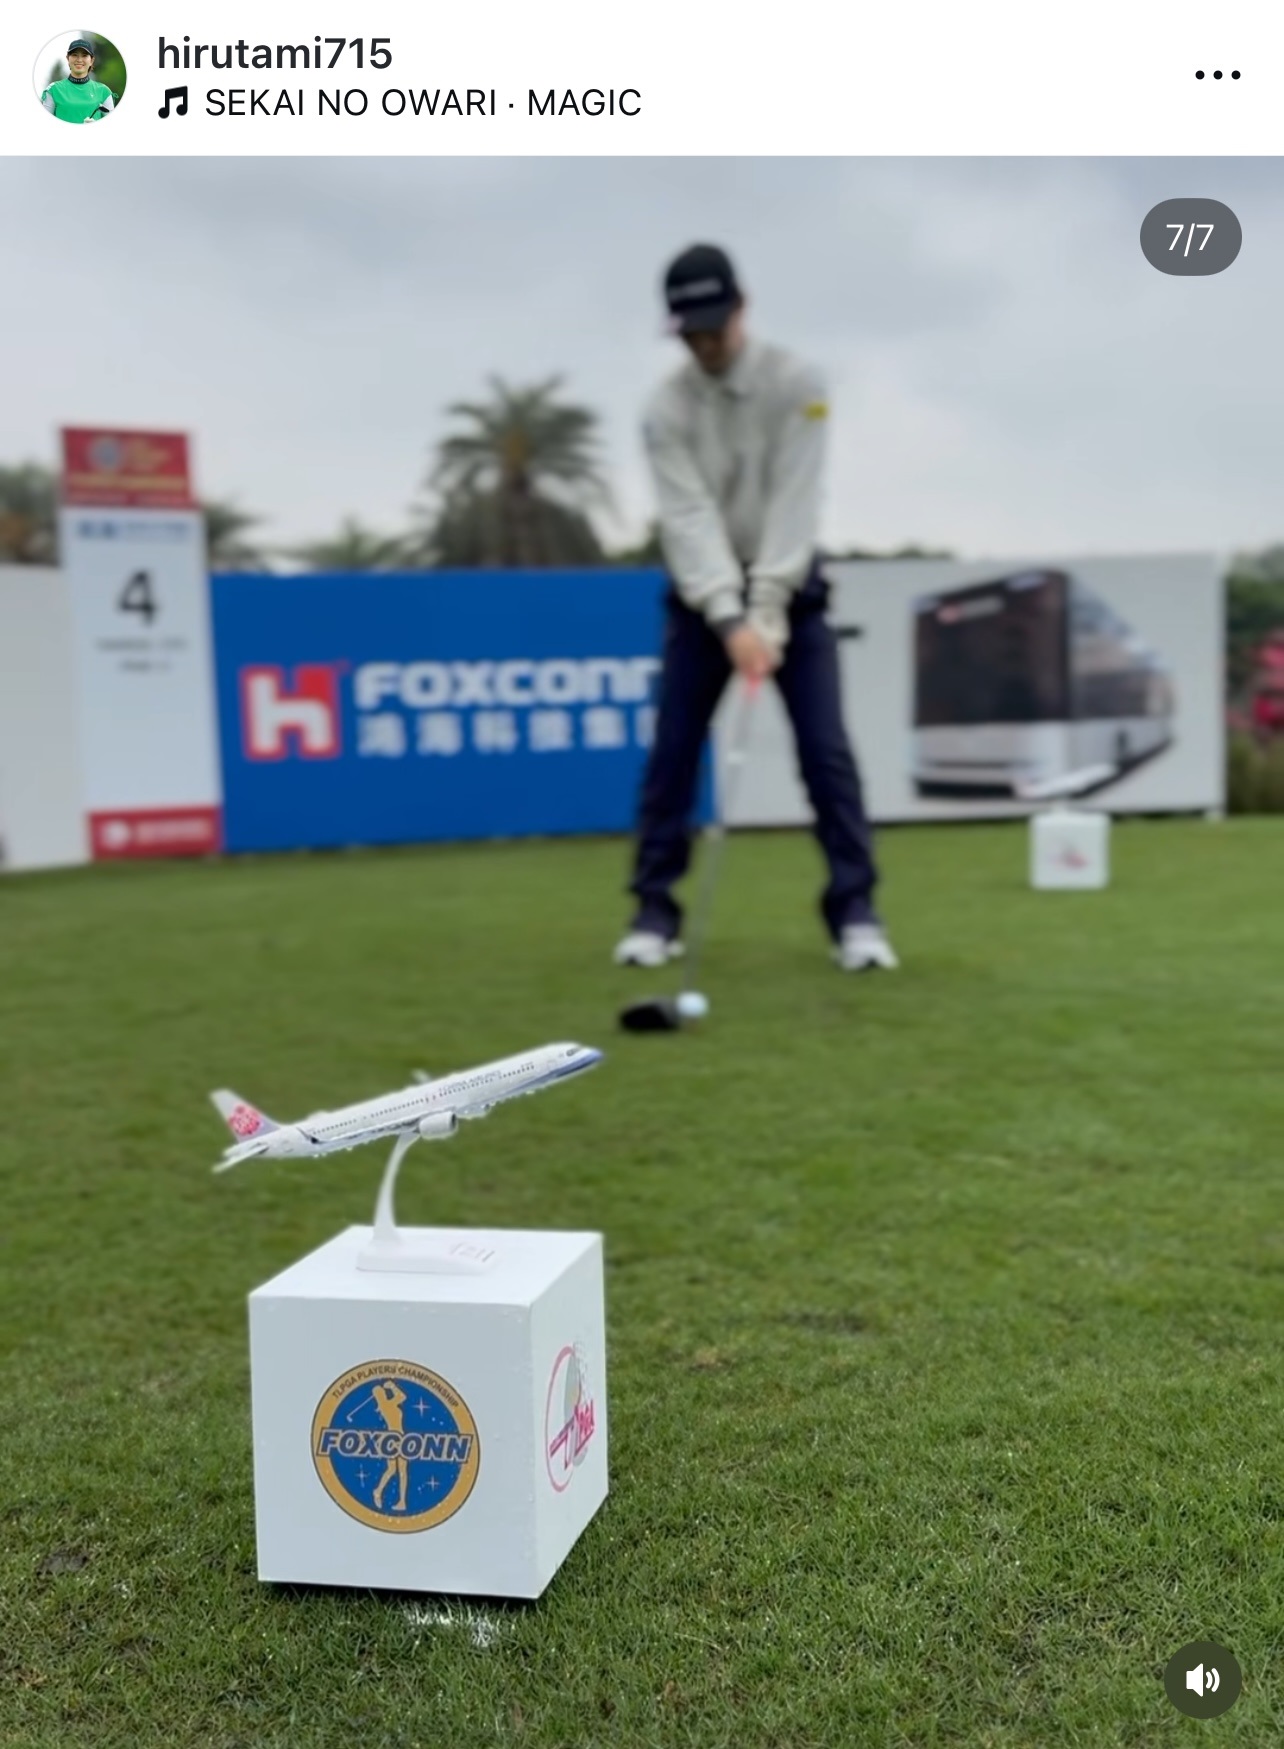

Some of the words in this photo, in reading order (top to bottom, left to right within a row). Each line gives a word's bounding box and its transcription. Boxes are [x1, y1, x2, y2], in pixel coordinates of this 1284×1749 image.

[118, 570, 157, 627] 4
[397, 1365, 459, 1408] CHAMPIONSHIP
[318, 1429, 472, 1462] FOXCONN
